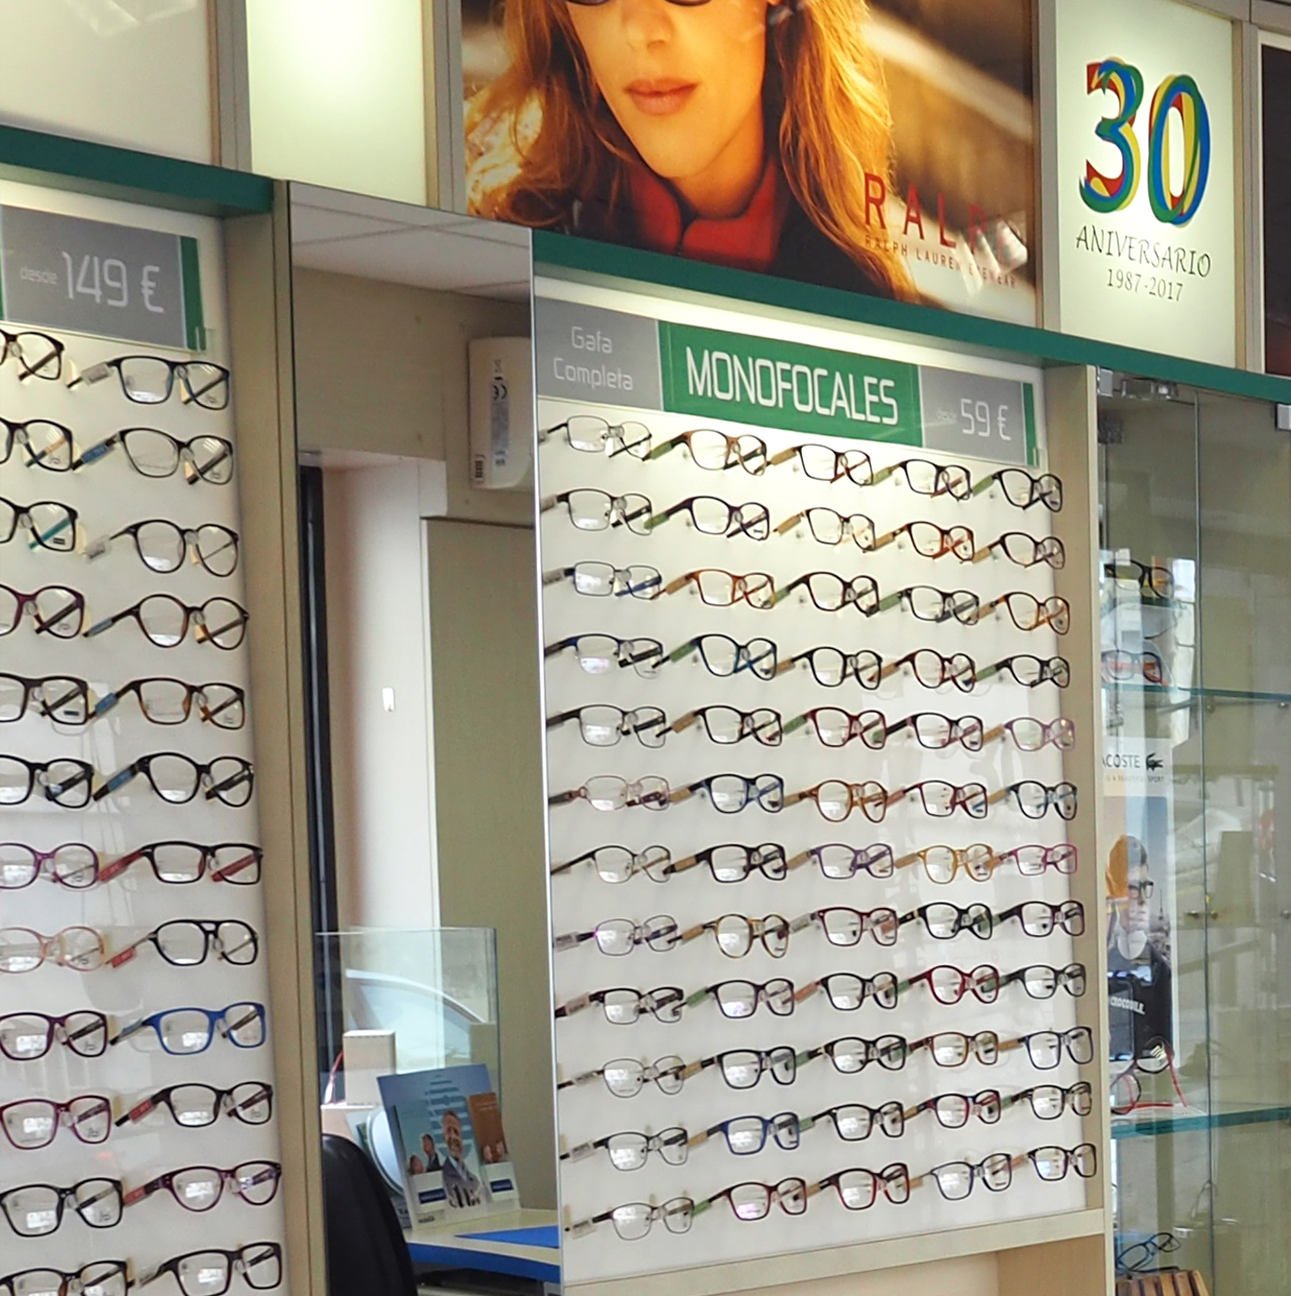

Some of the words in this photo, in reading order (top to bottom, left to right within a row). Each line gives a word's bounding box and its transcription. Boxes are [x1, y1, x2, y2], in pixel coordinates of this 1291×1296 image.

[1079, 56, 1210, 228] 30
[864, 172, 1008, 267] RALP
[865, 235, 908, 256] RALPH
[1076, 225, 1211, 278] ANIVERSARIO
[21, 266, 57, 284] desde
[62, 251, 128, 307] 149
[1107, 268, 1183, 301] 1987-2017
[571, 326, 612, 354] Gafa
[553, 357, 634, 392] Completa
[685, 346, 899, 426] MONOFOCALES
[961, 398, 990, 437] 59
